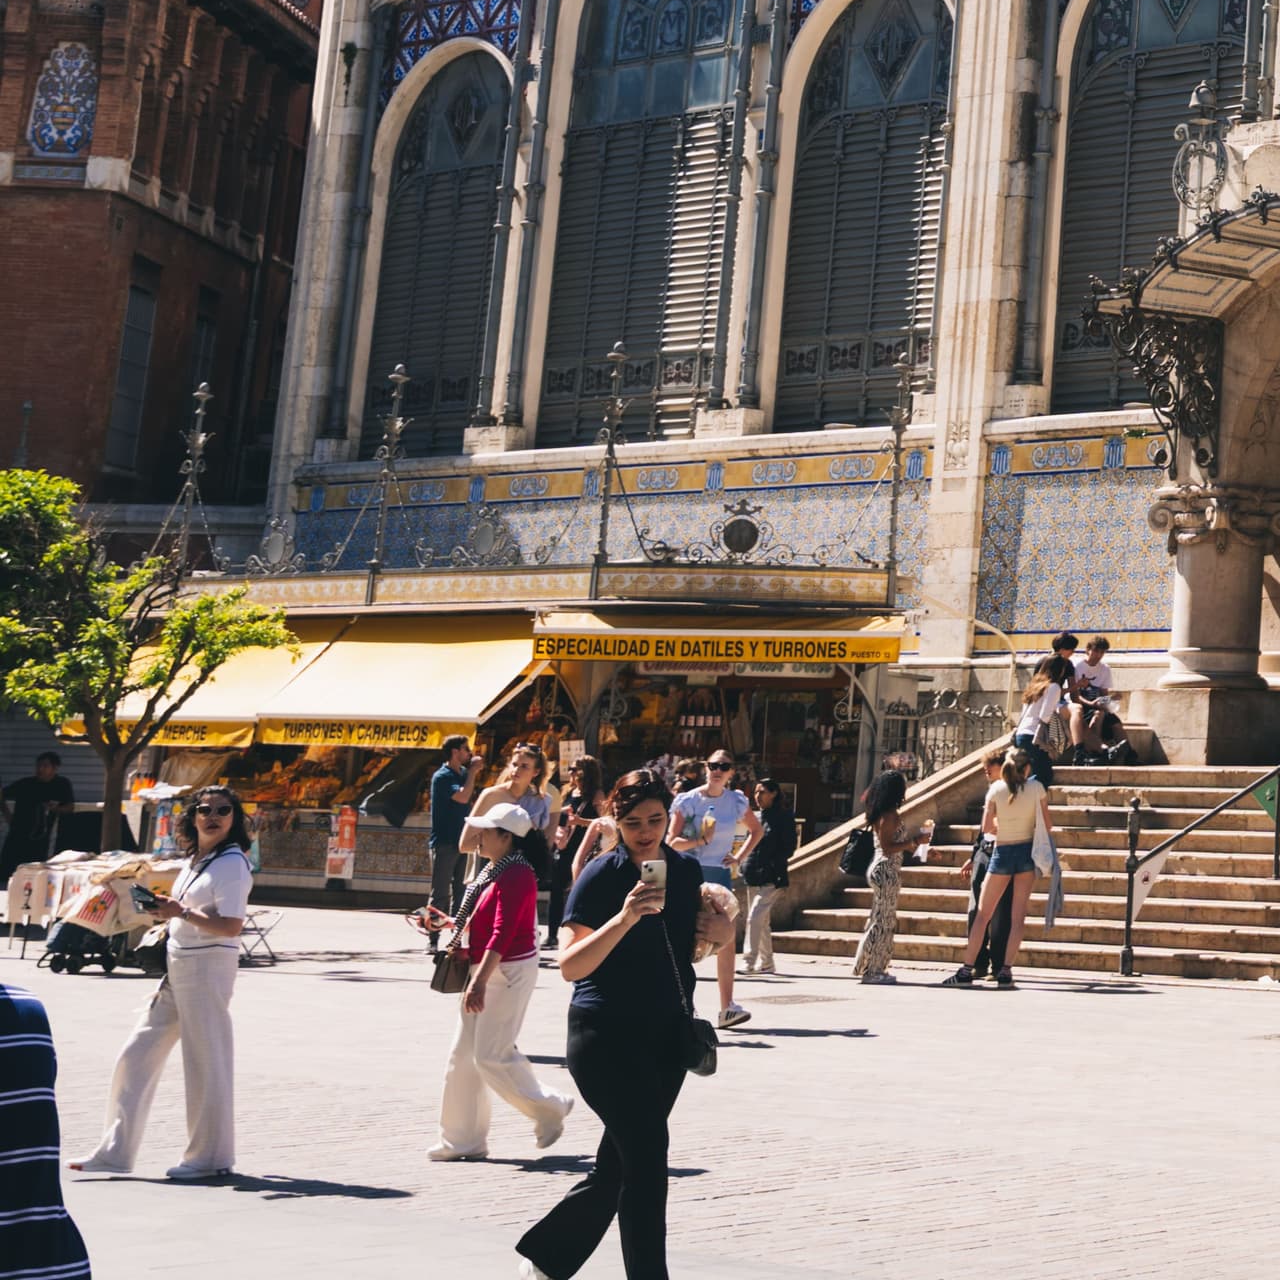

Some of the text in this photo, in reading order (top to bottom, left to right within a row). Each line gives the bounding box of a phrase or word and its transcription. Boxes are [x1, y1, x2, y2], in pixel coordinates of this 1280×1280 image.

[535, 637, 847, 659] ESPECIALIDAD EN DATILES Y TURRONES
[162, 723, 208, 741] MERCHE
[283, 722, 429, 742] TURRONES Y CARAMELOS
